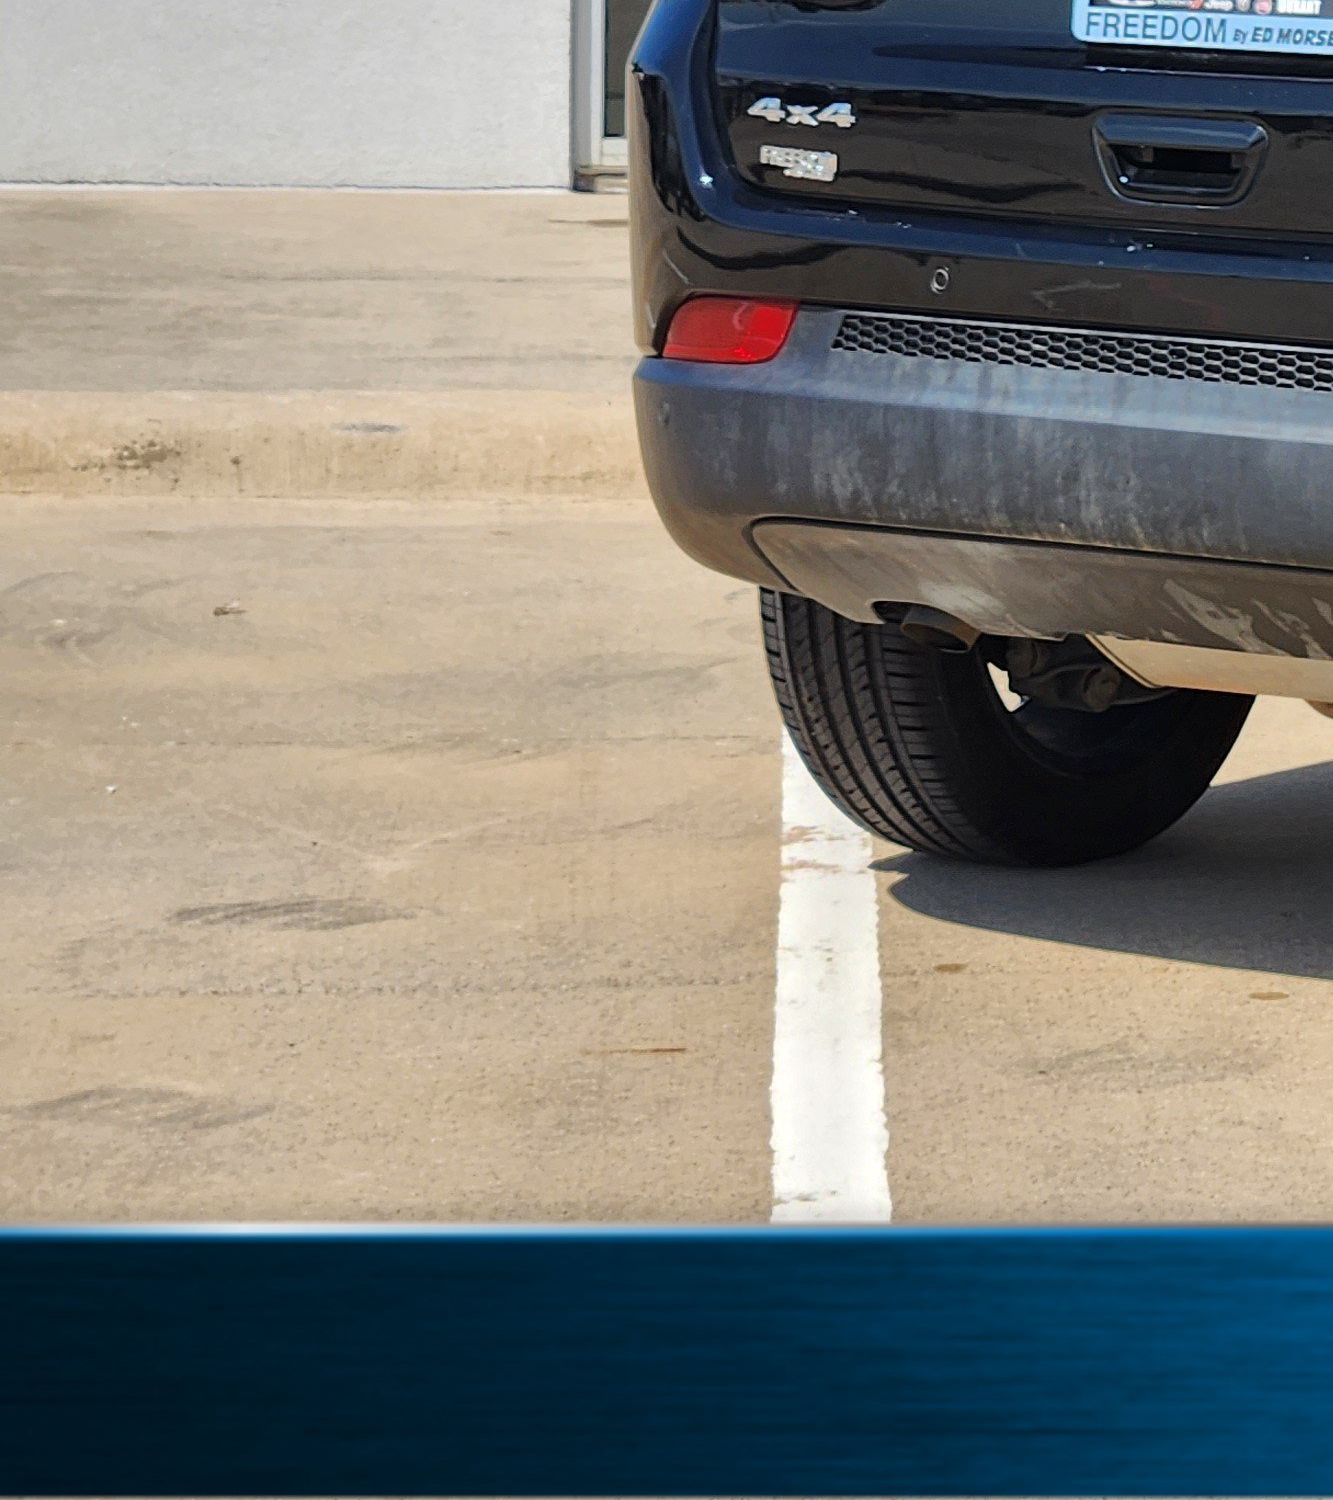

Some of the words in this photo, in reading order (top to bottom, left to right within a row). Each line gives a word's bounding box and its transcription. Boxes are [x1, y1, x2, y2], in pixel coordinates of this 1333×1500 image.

[1085, 12, 1227, 43] FREEDOM
[1252, 27, 1274, 44] ED
[747, 97, 856, 128] 4x4
